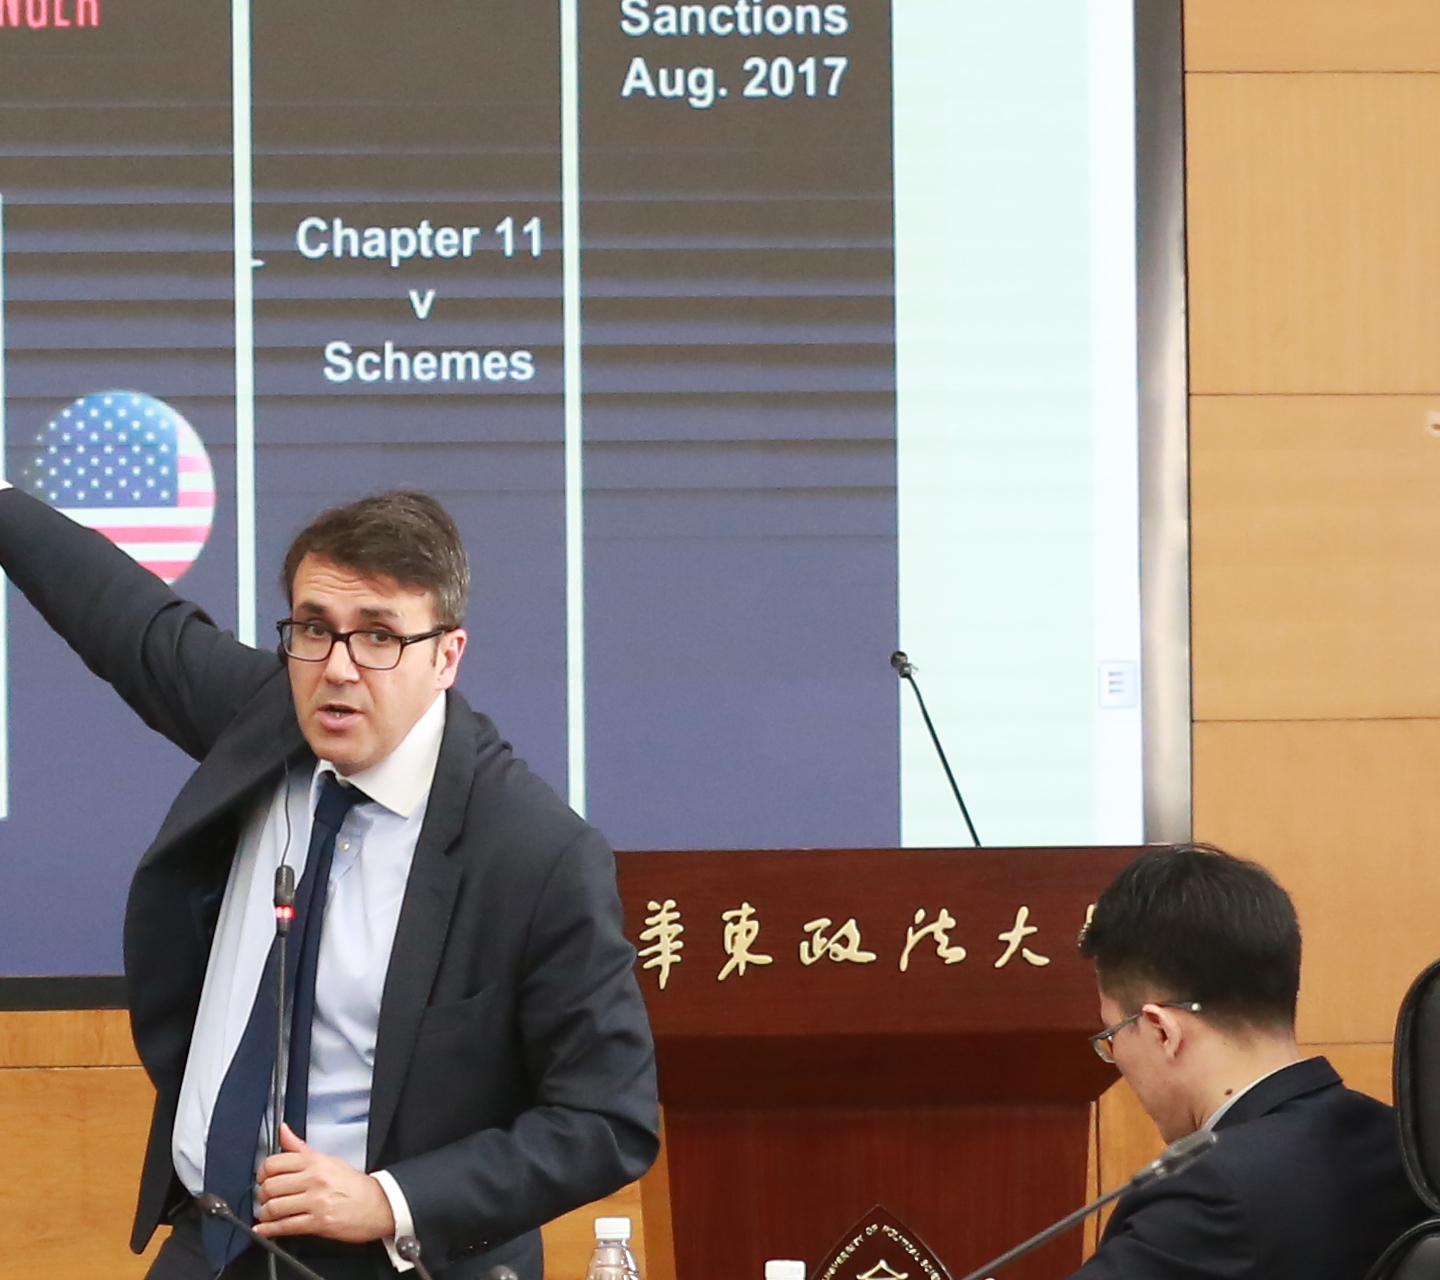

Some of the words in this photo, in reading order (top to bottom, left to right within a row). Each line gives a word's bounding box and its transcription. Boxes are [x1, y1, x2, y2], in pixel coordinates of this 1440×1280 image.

[622, 58, 729, 109] Aug.
[744, 57, 849, 98] 2017
[297, 218, 481, 268] Chapter
[496, 218, 542, 257] 11
[410, 291, 436, 320] v
[325, 342, 535, 383] Schemes
[638, 900, 1095, 990] 華東政法大
